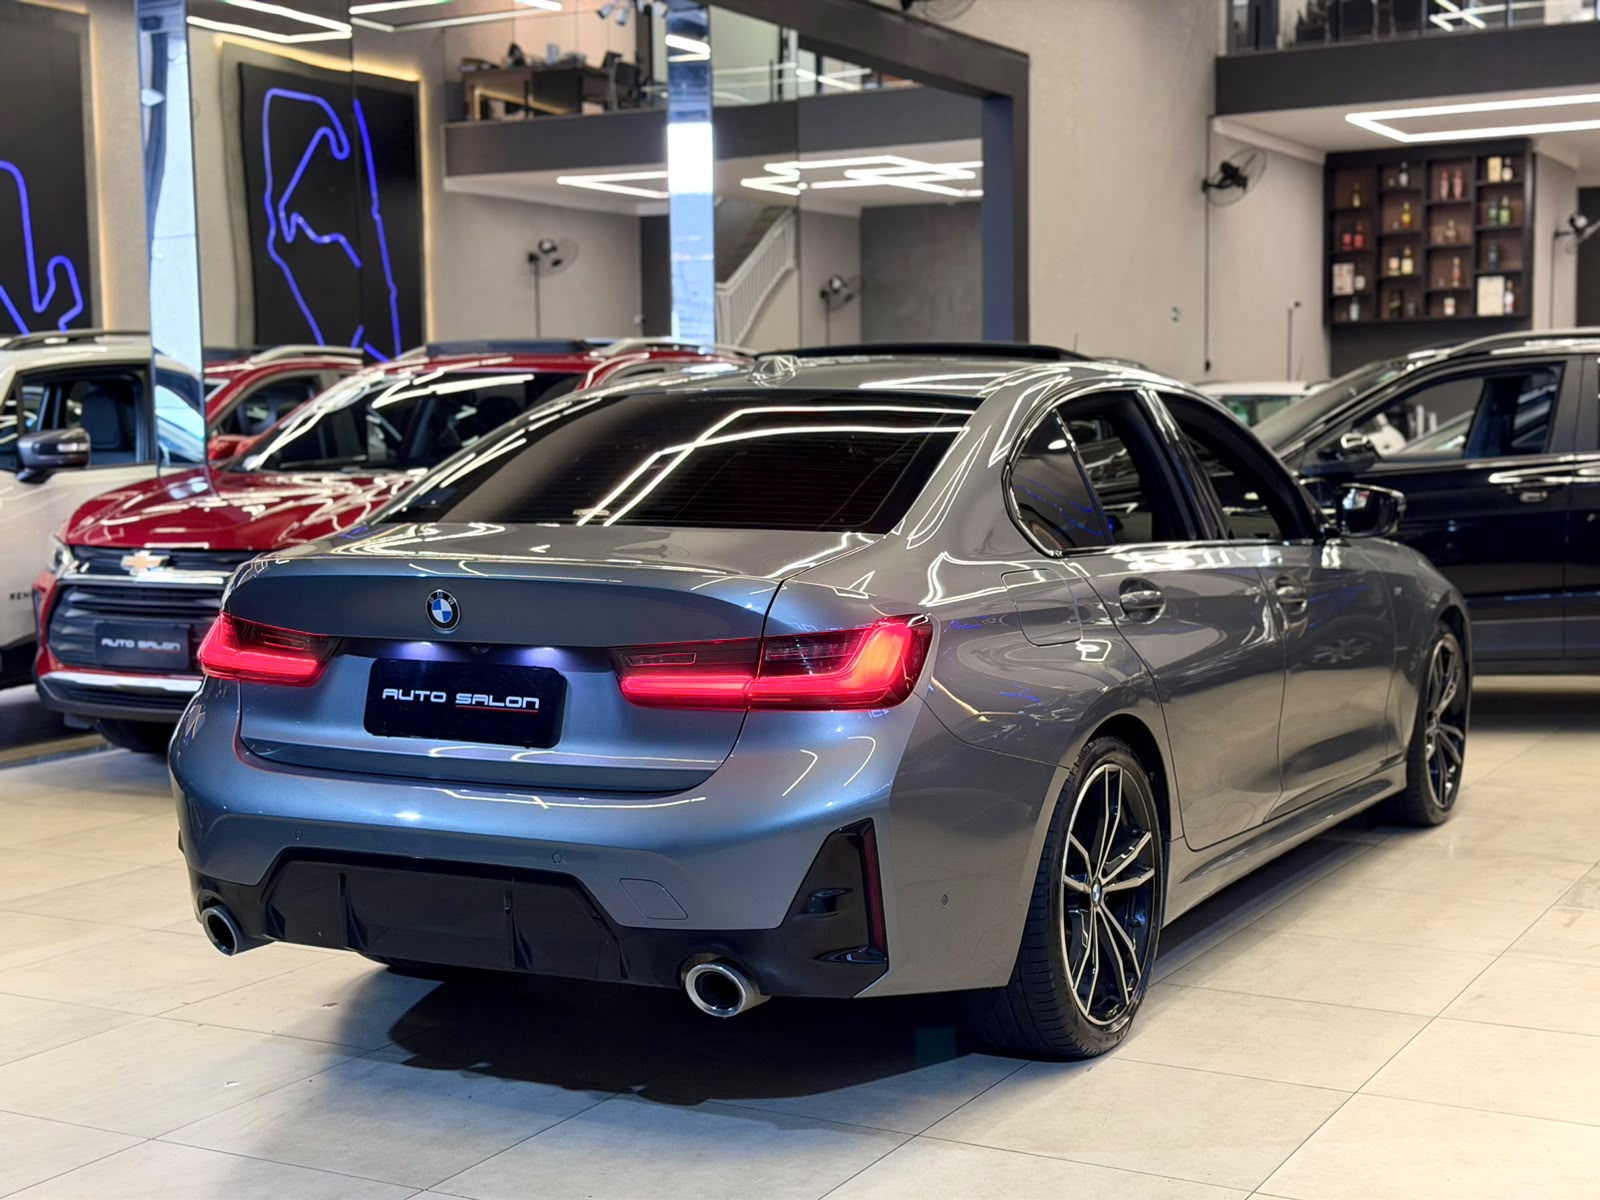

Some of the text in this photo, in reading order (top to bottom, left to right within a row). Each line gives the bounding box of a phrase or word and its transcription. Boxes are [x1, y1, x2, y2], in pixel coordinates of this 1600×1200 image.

[101, 638, 181, 651] AUTO SALON
[382, 688, 539, 709] AUTO SALON
